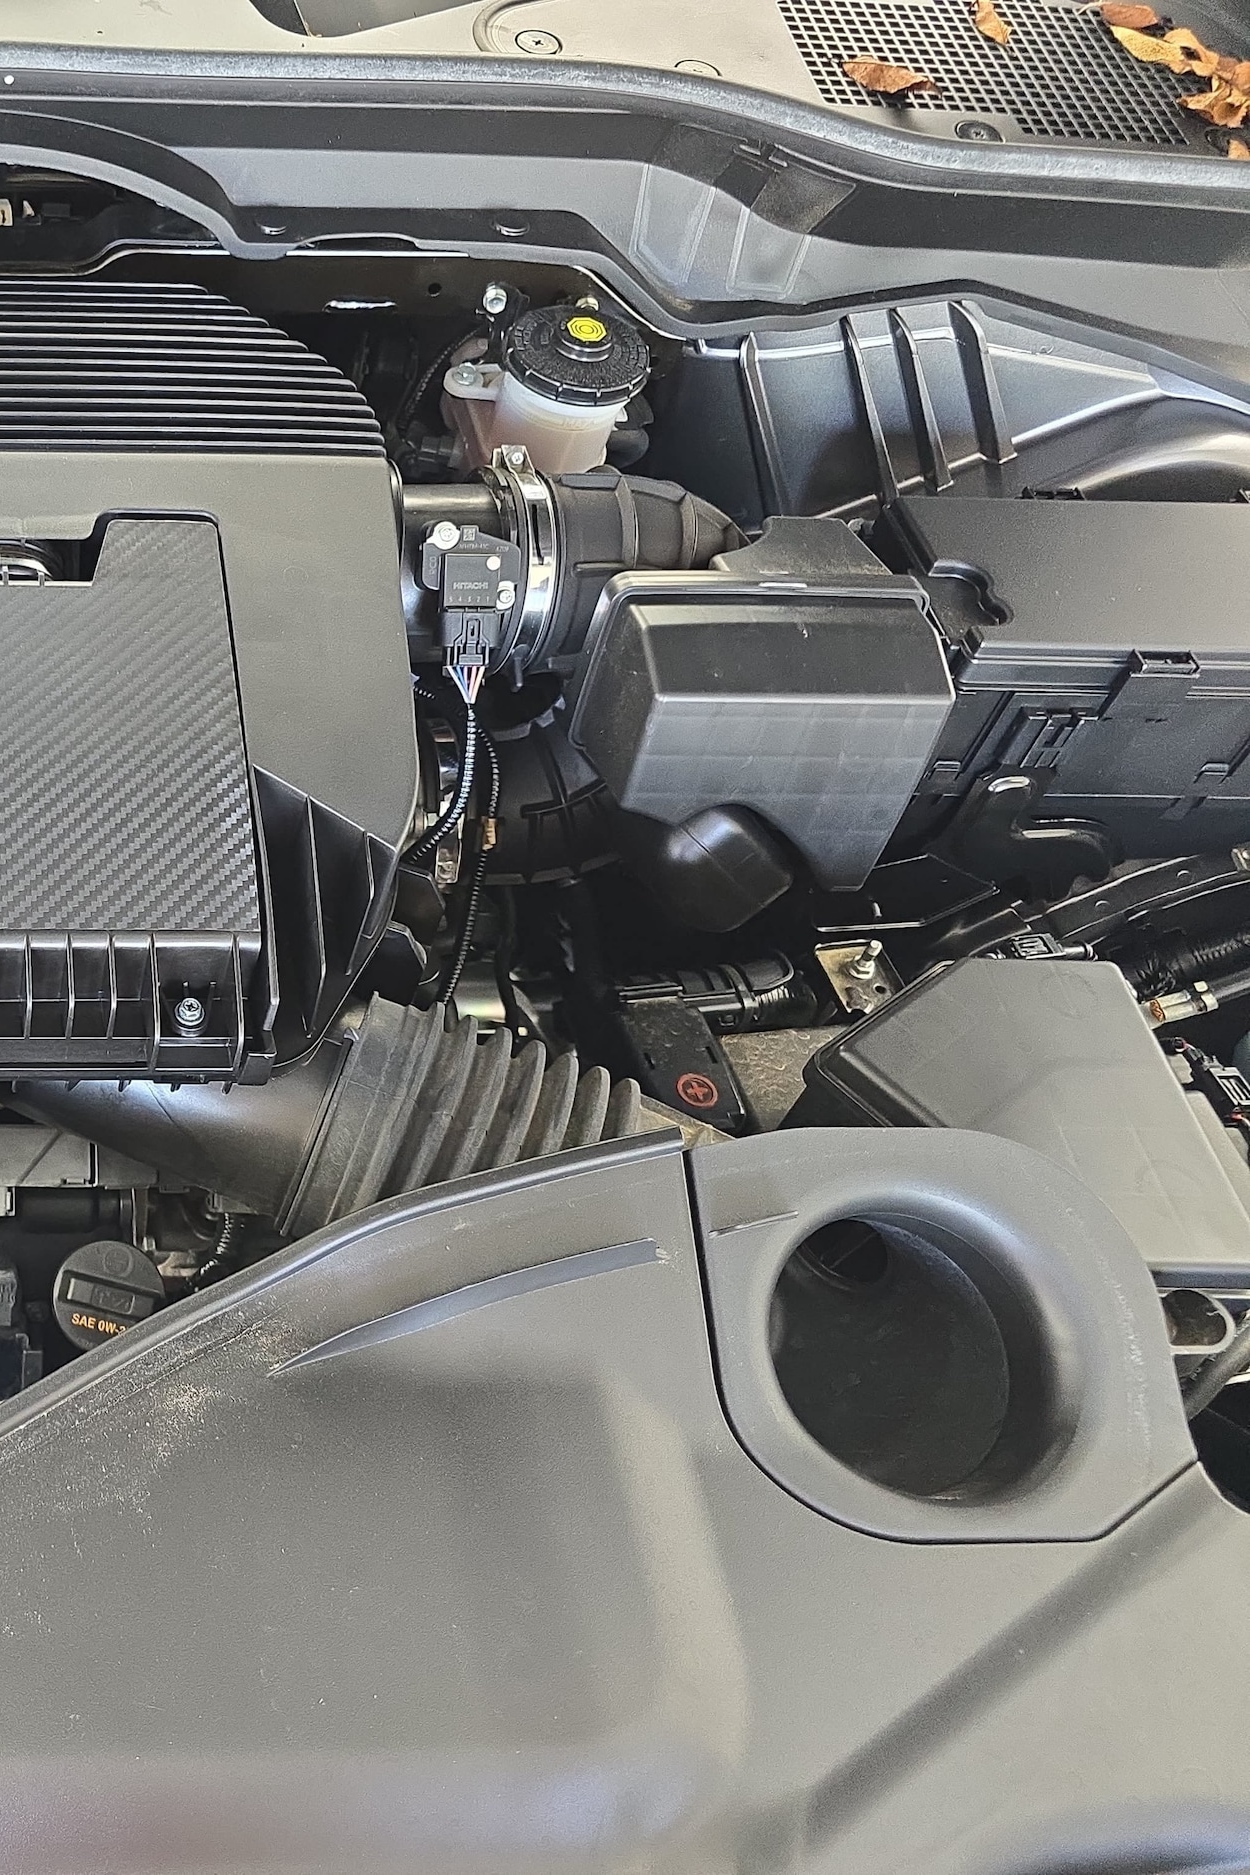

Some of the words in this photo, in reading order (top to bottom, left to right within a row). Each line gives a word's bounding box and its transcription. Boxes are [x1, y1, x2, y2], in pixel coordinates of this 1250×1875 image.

[453, 582, 489, 590] HITACHI
[71, 1313, 97, 1329] SAE
[97, 1319, 127, 1336] 0W-2
